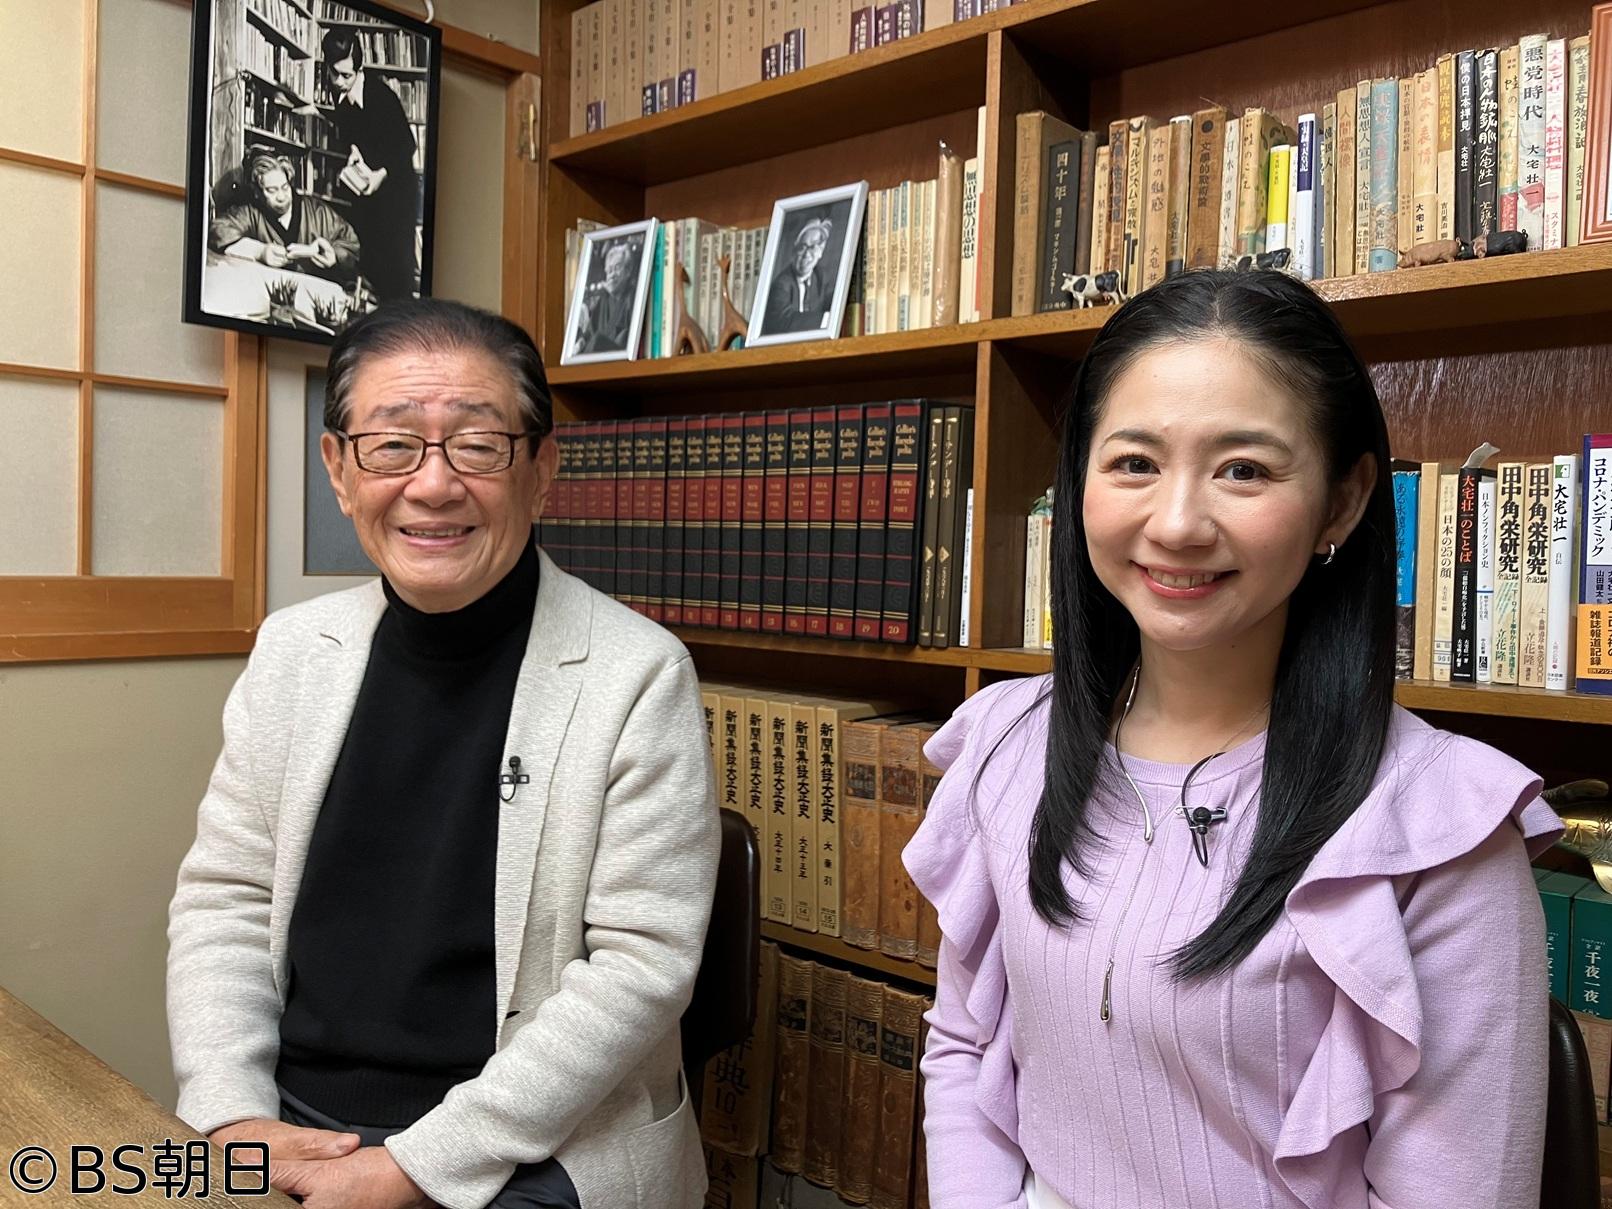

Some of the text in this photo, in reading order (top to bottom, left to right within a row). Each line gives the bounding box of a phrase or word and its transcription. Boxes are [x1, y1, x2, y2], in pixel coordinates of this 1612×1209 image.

[1522, 46, 1543, 195] 悪党時代 大宅壮一
[963, 171, 977, 260] 無思想の思想
[1460, 475, 1476, 564] 大宅壮一のことば
[1498, 467, 1521, 574] 田中角栄研究
[1526, 470, 1549, 576] 田中角栄研究
[1552, 483, 1569, 543] 大宅壮一
[1592, 457, 1608, 558] コロナ・パンデミック
[1440, 514, 1454, 579] 日本の25の顔
[862, 623, 870, 633] 19
[888, 625, 900, 635] 20
[1590, 610, 1602, 666] 雑誌報道記録
[1583, 951, 1602, 1004] 千夜一夜
